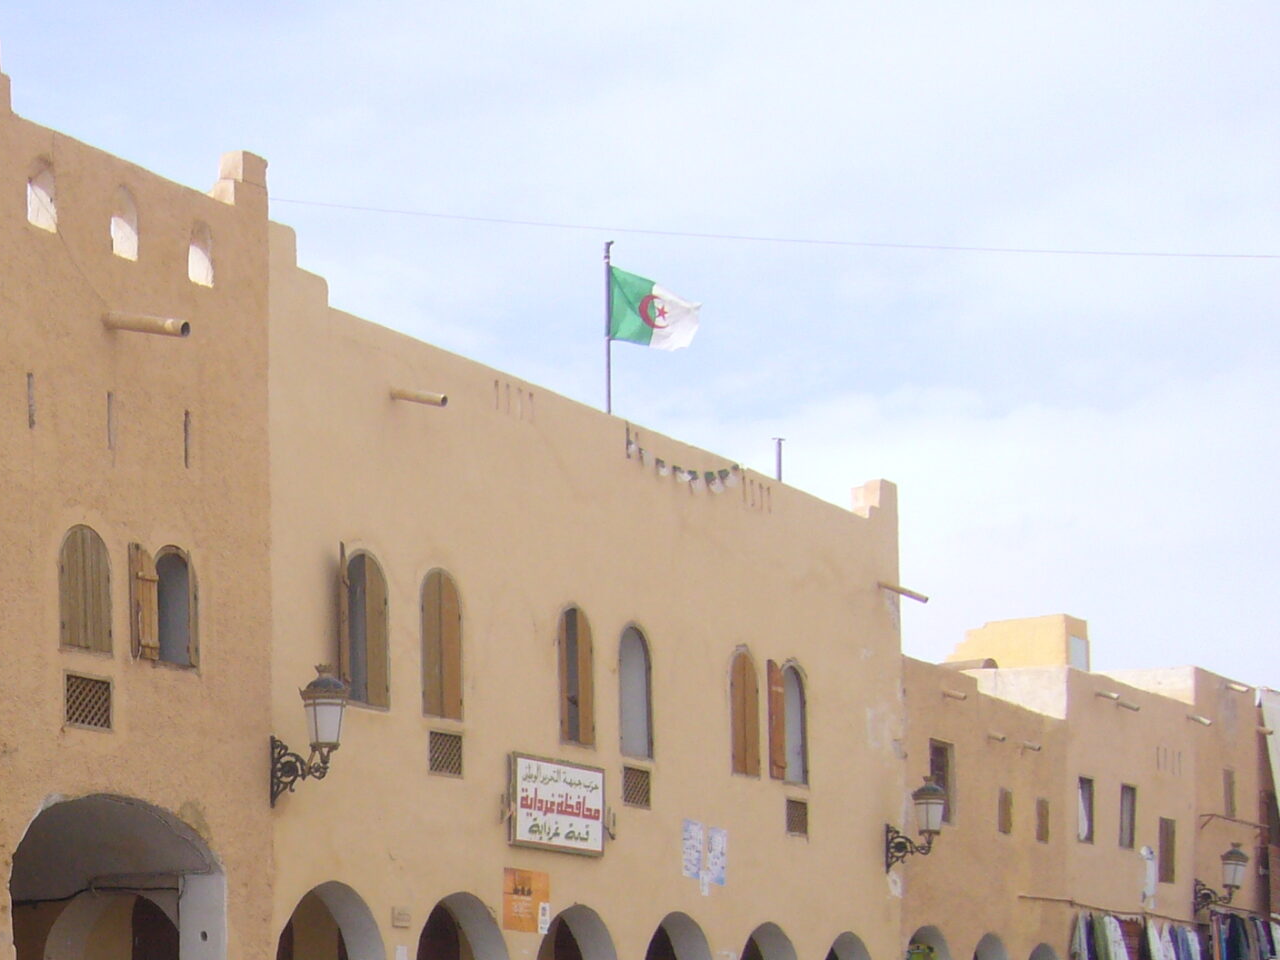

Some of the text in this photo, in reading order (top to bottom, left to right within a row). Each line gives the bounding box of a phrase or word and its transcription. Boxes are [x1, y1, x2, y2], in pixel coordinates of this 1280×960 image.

[520, 787, 600, 821] محافظة غرداية
[528, 817, 561, 841] غرداية
